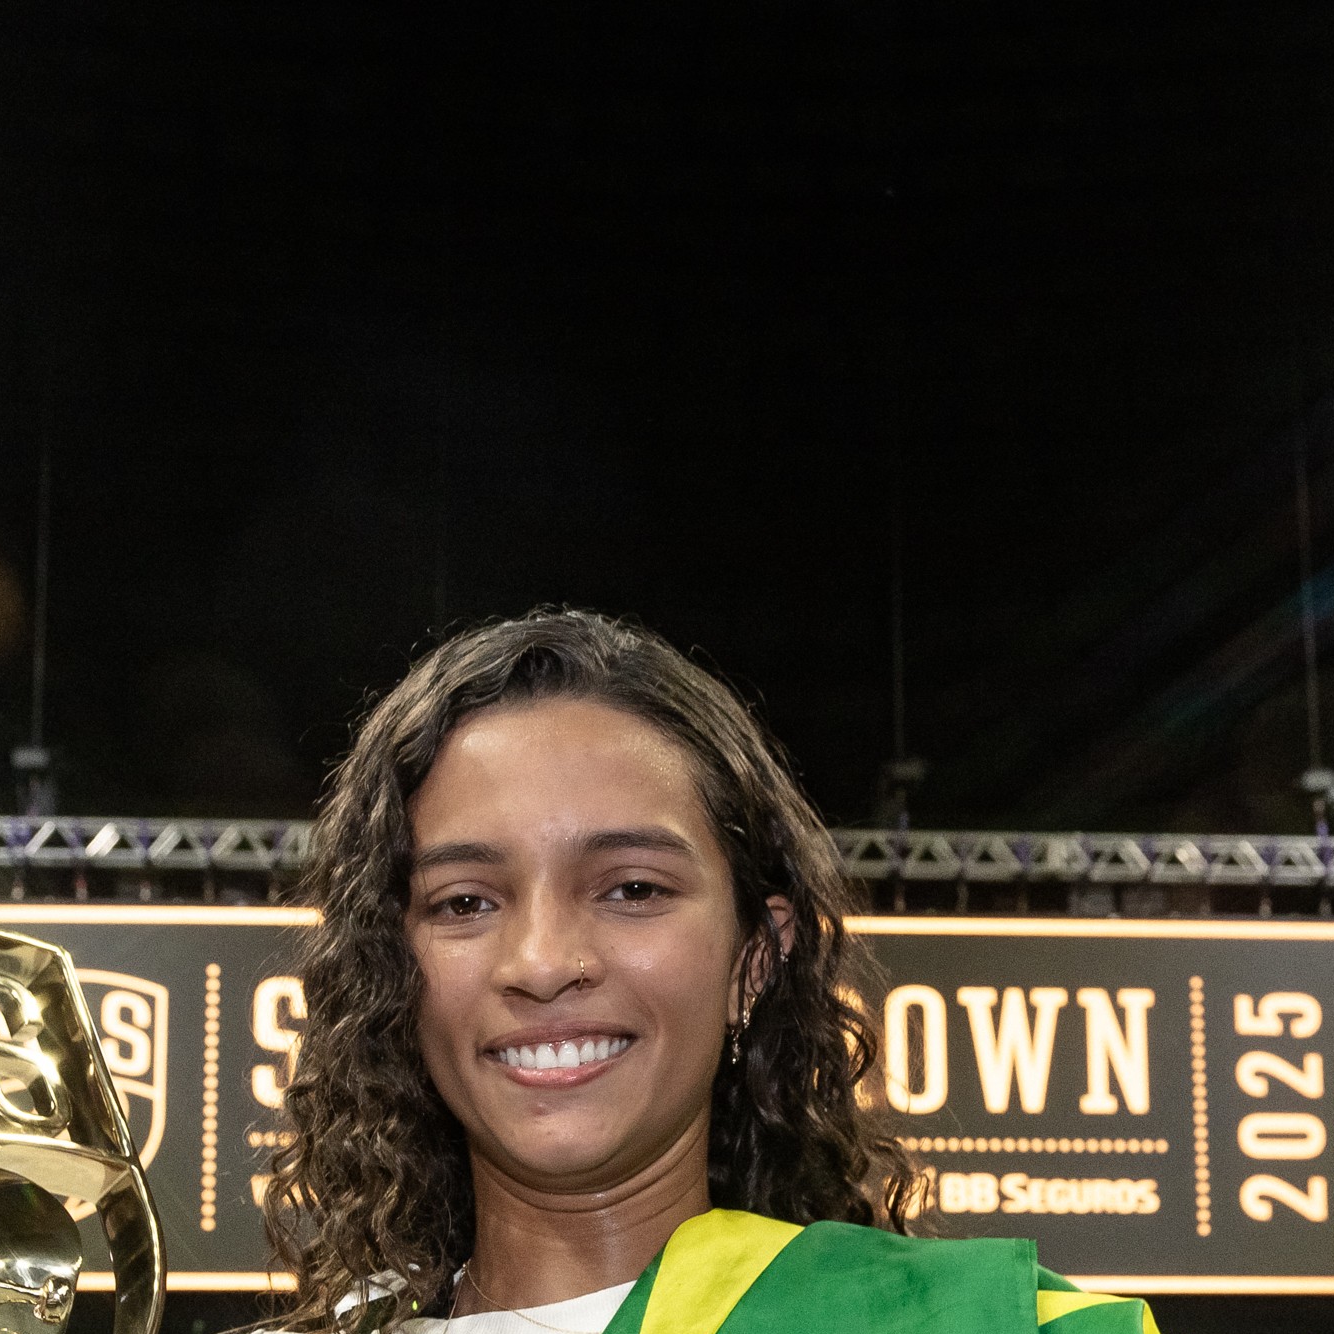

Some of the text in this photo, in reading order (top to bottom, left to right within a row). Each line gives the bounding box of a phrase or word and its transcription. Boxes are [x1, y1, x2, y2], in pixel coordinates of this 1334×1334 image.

[832, 983, 1156, 1116] OWN
[1234, 991, 1328, 1223] 2025
[939, 1172, 1000, 1214] BB
